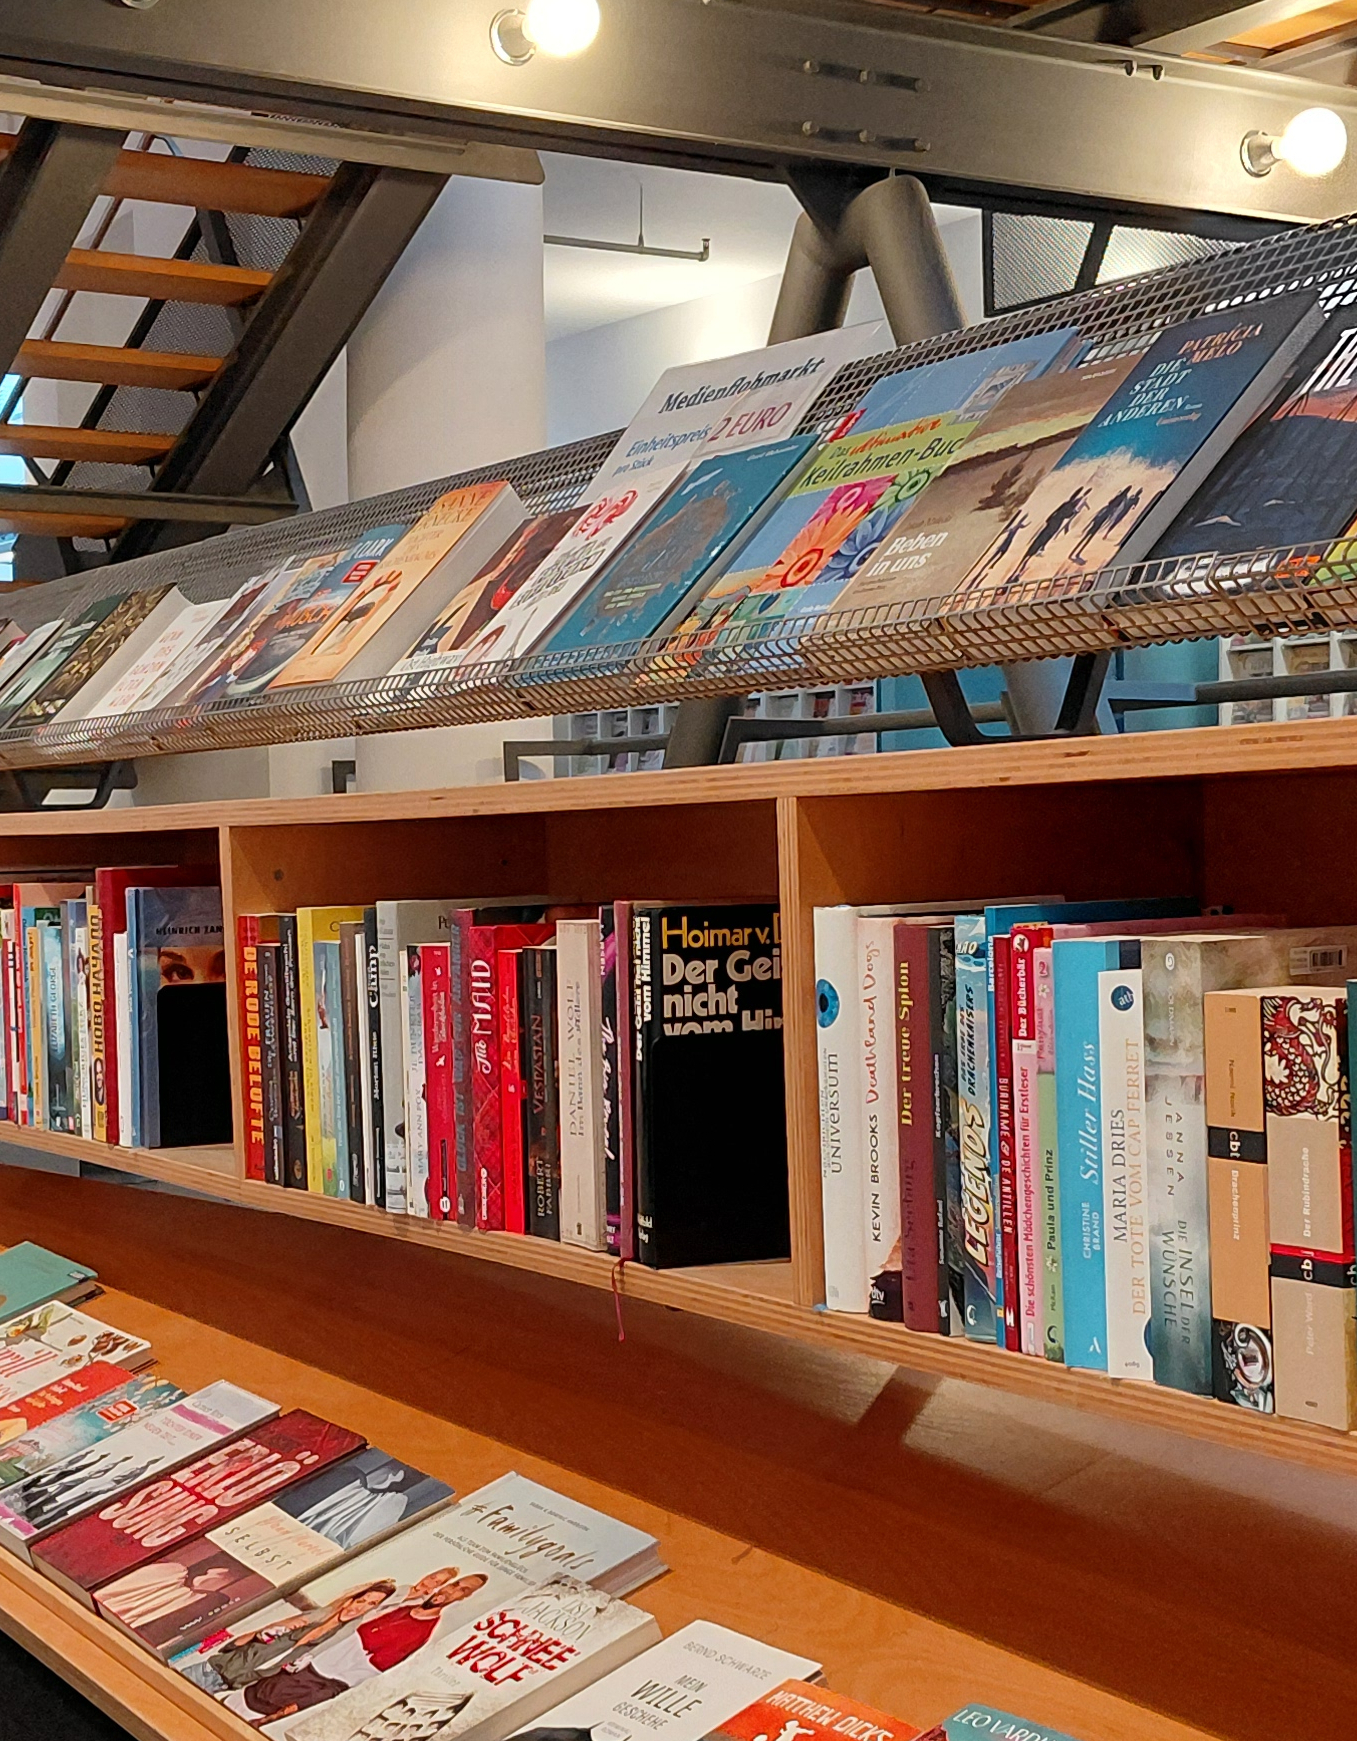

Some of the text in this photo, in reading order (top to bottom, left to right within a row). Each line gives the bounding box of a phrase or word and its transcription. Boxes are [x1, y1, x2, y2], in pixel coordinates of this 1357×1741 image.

[1177, 323, 1264, 355] PATRÍCIA
[1187, 341, 1243, 366] MELO
[658, 357, 826, 414] Medienflohmarkt
[1129, 369, 1193, 395] STADT
[1149, 358, 1187, 378] DIE
[1098, 395, 1190, 428] ANDEREN
[1128, 387, 1170, 408] DER
[625, 424, 712, 458] Einheitspreis
[706, 416, 733, 443] 2
[725, 402, 793, 439] EURO
[849, 418, 942, 457] ultimative
[866, 551, 933, 578] in uns
[884, 532, 949, 557] Beben
[661, 913, 771, 949] Hoimar v.
[662, 953, 720, 986] Der
[987, 935, 995, 993] Barcelona
[470, 958, 493, 1037] MAID
[643, 984, 652, 1022] vom
[663, 984, 740, 1019] nicht
[1017, 957, 1027, 1037] Der Bücherbär
[93, 1001, 104, 1053] НОВО
[243, 946, 265, 1145] DE RODE BELOFTE
[899, 961, 913, 1127] Der treue Spion
[530, 1013, 543, 1115] VESPASIAN
[863, 940, 882, 1244] KEVIN BROOKS Deathland Dogs
[568, 1057, 577, 1137] DANIEL
[1077, 1042, 1099, 1187] Stiller Hass
[1164, 1095, 1175, 1197] JESSEN
[1175, 1111, 1185, 1182] ANNA
[1228, 1131, 1241, 1159] cbt
[961, 1100, 991, 1269] LEGENDS
[1001, 1159, 1013, 1234] DE ANTILLEN
[1019, 1066, 1036, 1318] Die schönsten Mädchengeschichten für Erstleser
[1044, 1148, 1056, 1252] Paula und Prinz
[1111, 1108, 1128, 1244] MARIA DRIES
[1124, 1037, 1146, 1315] DER TOTE VOM CAP FERRET
[1302, 1146, 1312, 1238] Der Rubindrache
[1082, 1201, 1092, 1260] CHRISTINE
[1091, 1210, 1100, 1251] BRAND
[1161, 1229, 1178, 1328] WÜNSCHE
[1177, 1219, 1194, 1345] DIE INSEL DER
[170, 1438, 320, 1507] ERLÖ
[98, 1481, 219, 1548] SUNG
[459, 1500, 599, 1570] #Familygoals
[225, 1526, 293, 1571] SELBST
[520, 1603, 596, 1643] JACKSON
[560, 1599, 593, 1619] LISA
[446, 1634, 539, 1687] WOLF
[473, 1610, 582, 1672] SCHNEE
[683, 1640, 773, 1681] BERND SCHWARZE
[630, 1679, 703, 1720] WILLE
[674, 1674, 708, 1694] MEIN
[612, 1701, 669, 1731] GESCHEHE
[766, 1689, 895, 1741] MATTHEW DICKS
[952, 1708, 992, 1729] LEO
